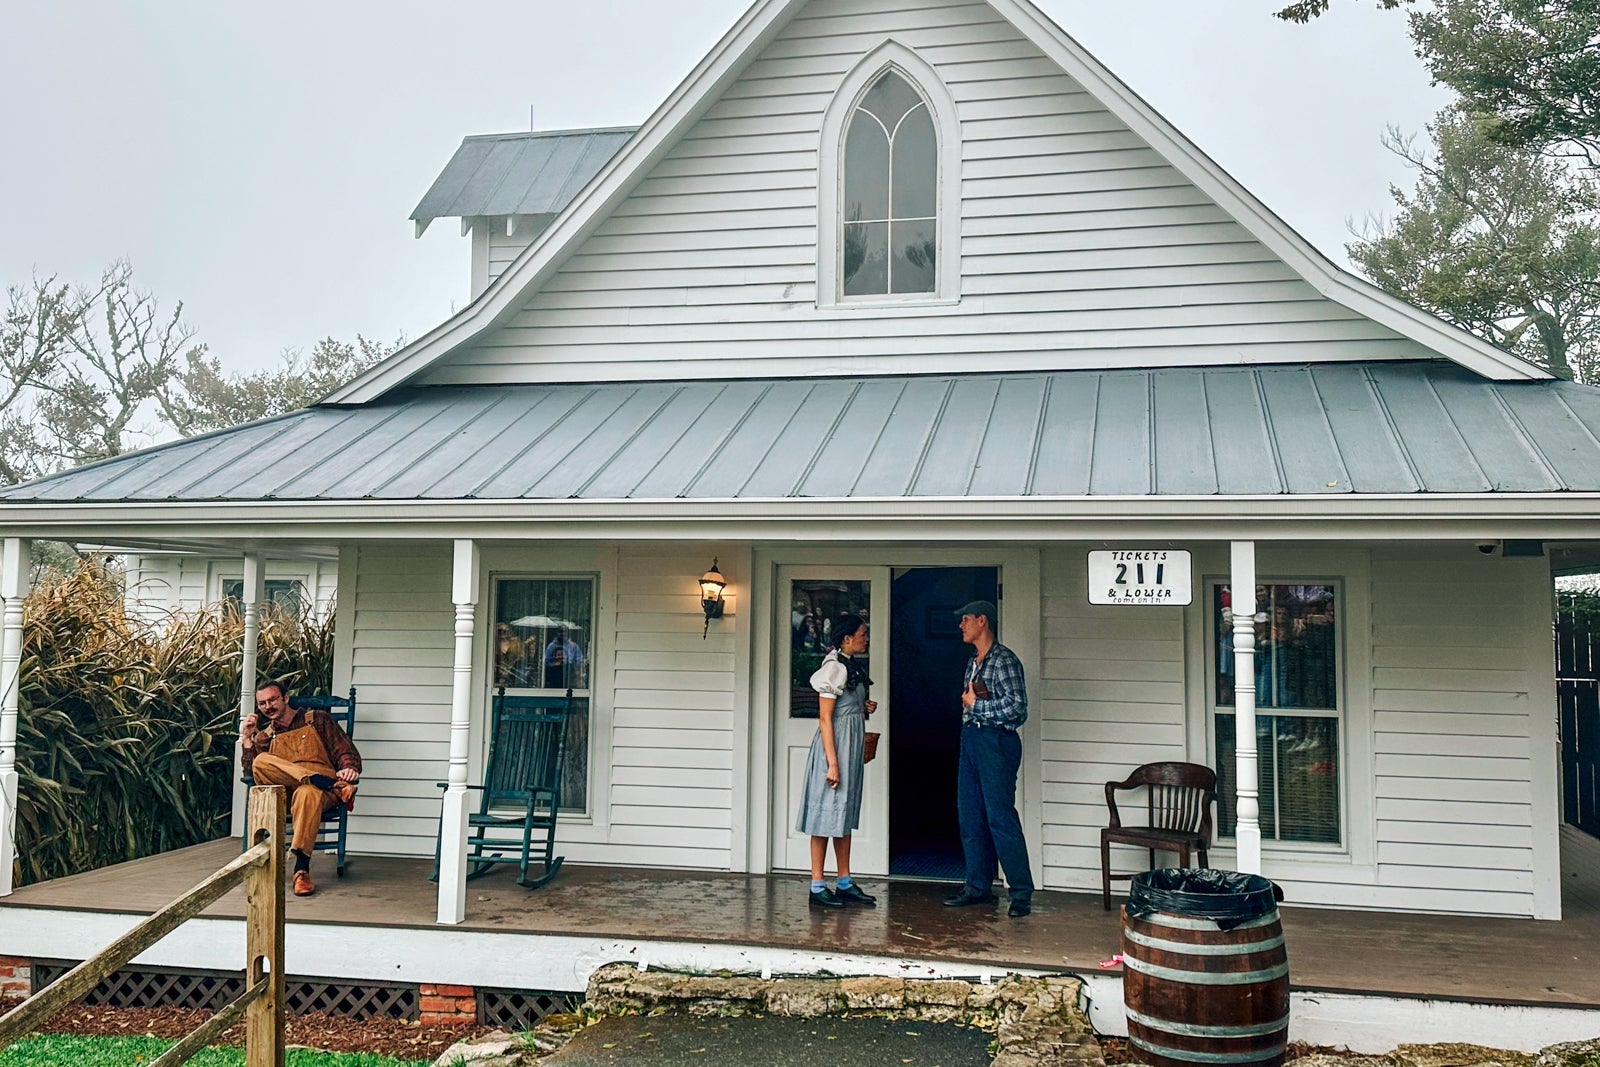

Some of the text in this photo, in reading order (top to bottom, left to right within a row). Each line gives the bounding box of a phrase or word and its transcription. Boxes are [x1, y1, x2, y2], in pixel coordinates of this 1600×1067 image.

[1112, 552, 1167, 560] TICKETS
[1108, 588, 1171, 597] & LOWER
